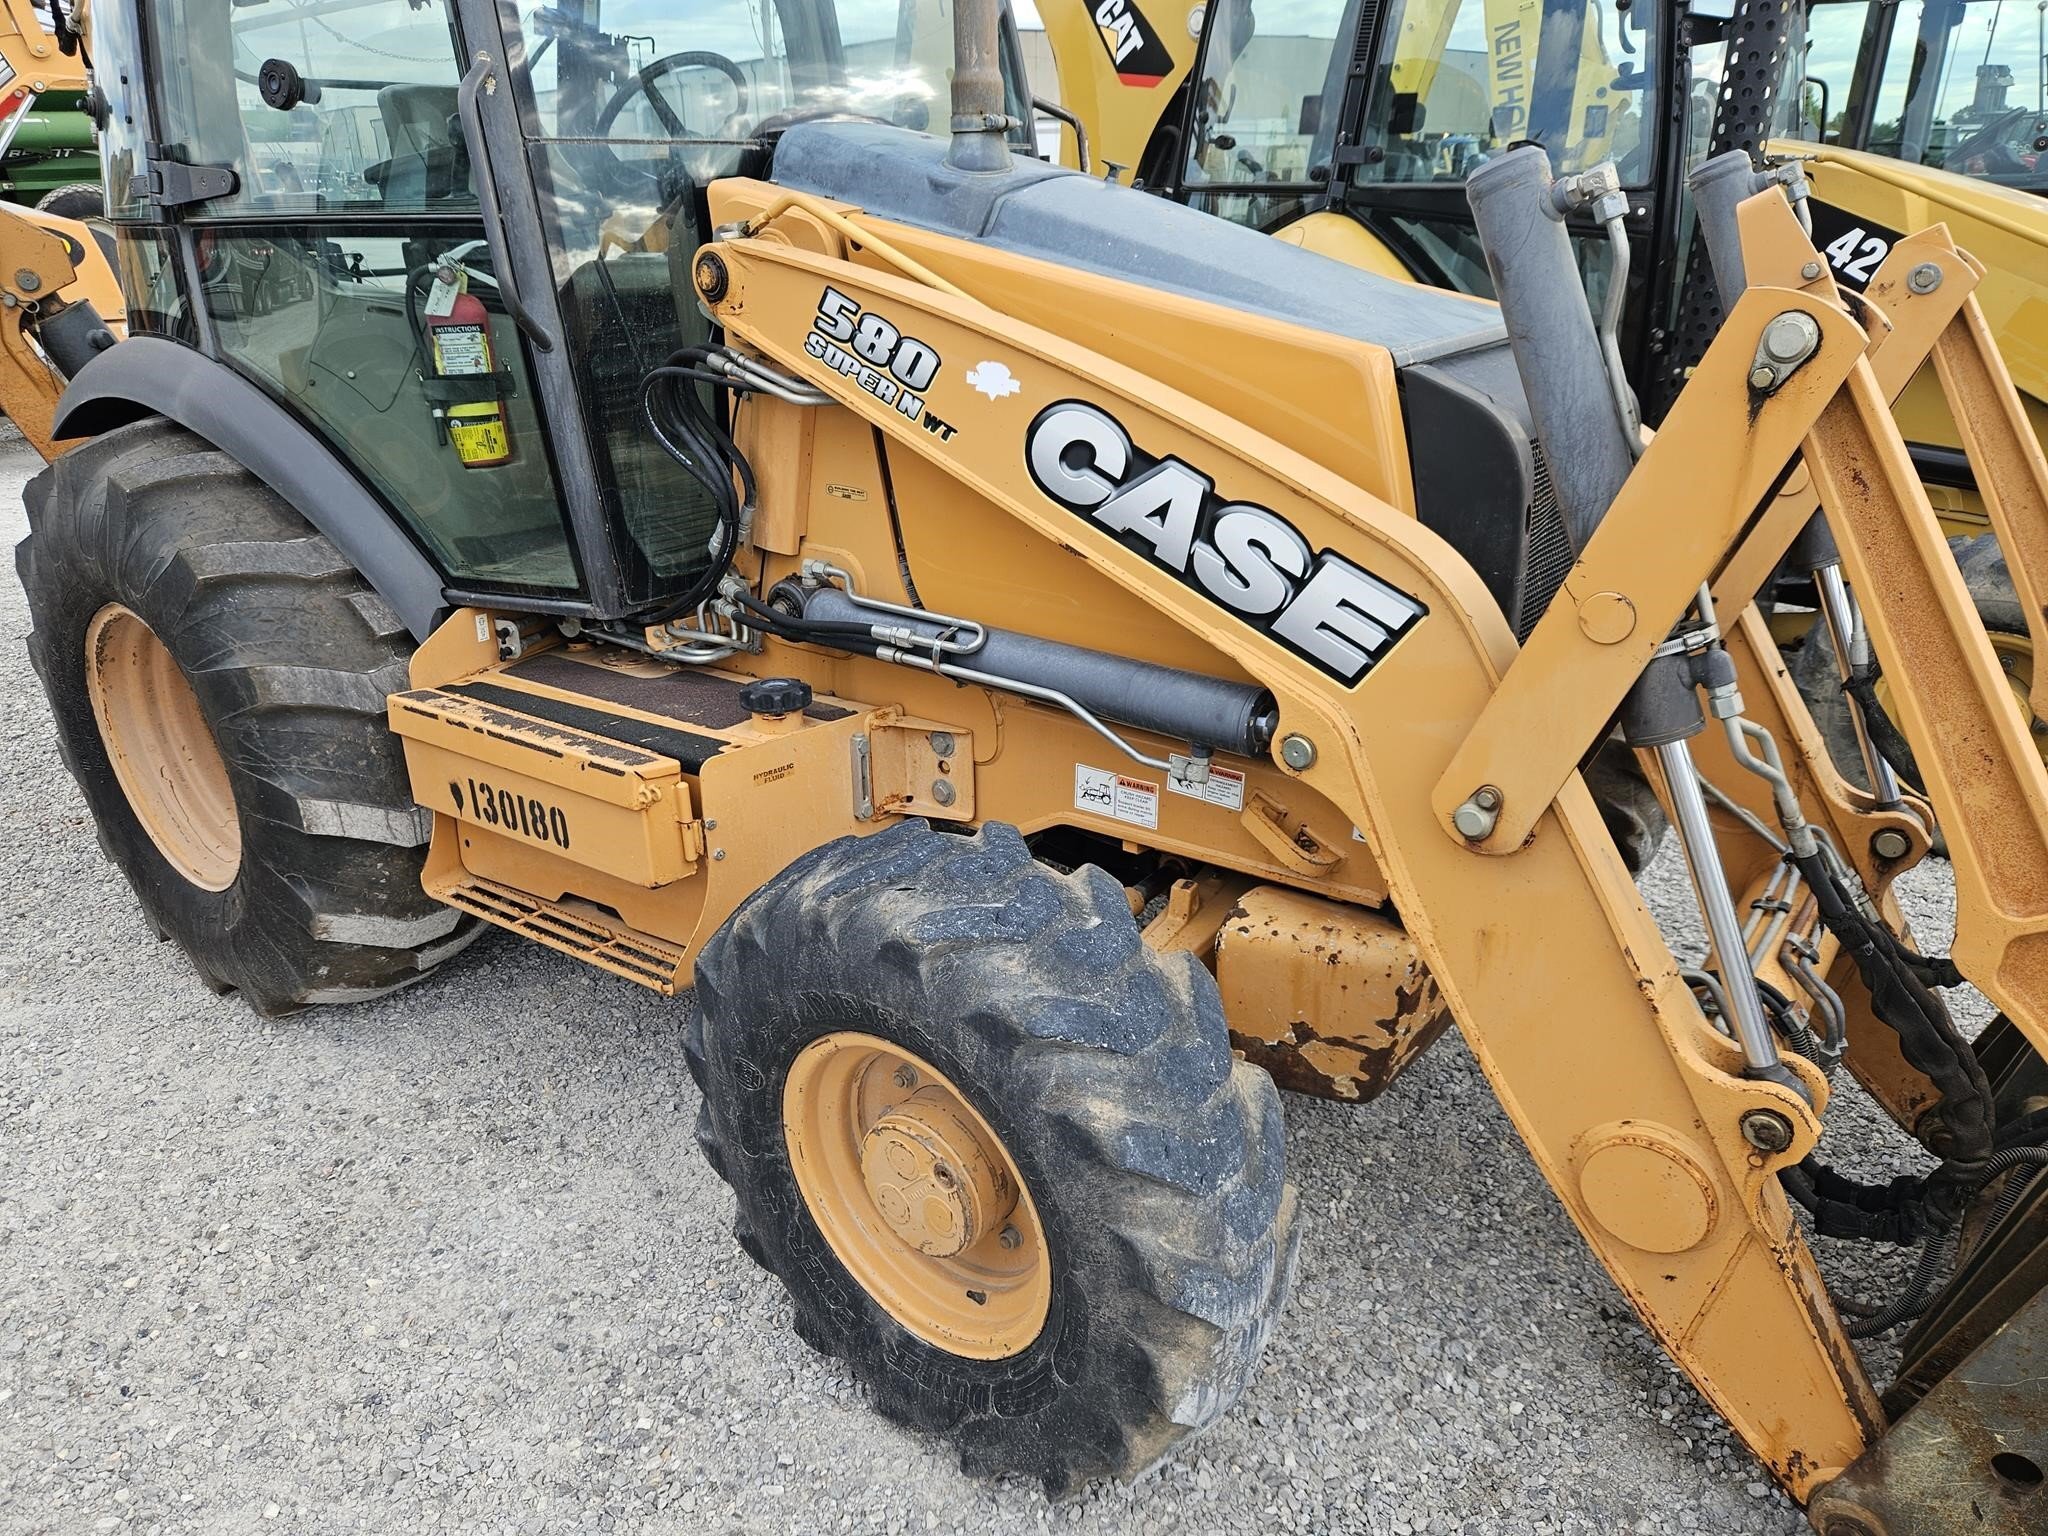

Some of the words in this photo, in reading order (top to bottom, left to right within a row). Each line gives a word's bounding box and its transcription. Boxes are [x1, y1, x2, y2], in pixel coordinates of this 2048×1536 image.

[1096, 0, 1145, 66] CAT
[1495, 20, 1523, 82] NEW
[435, 325, 481, 333] INSTRUCTIONS
[813, 285, 942, 392] 580
[804, 331, 900, 405] SUPER
[896, 389, 926, 421] N
[922, 411, 958, 442] WT
[1026, 401, 1428, 686] CASE
[753, 763, 795, 781] HYDRAULIC
[764, 773, 785, 784] FLUID
[1126, 781, 1155, 794] WARNING
[1214, 769, 1243, 781] WARNING
[468, 778, 570, 850] 130180
